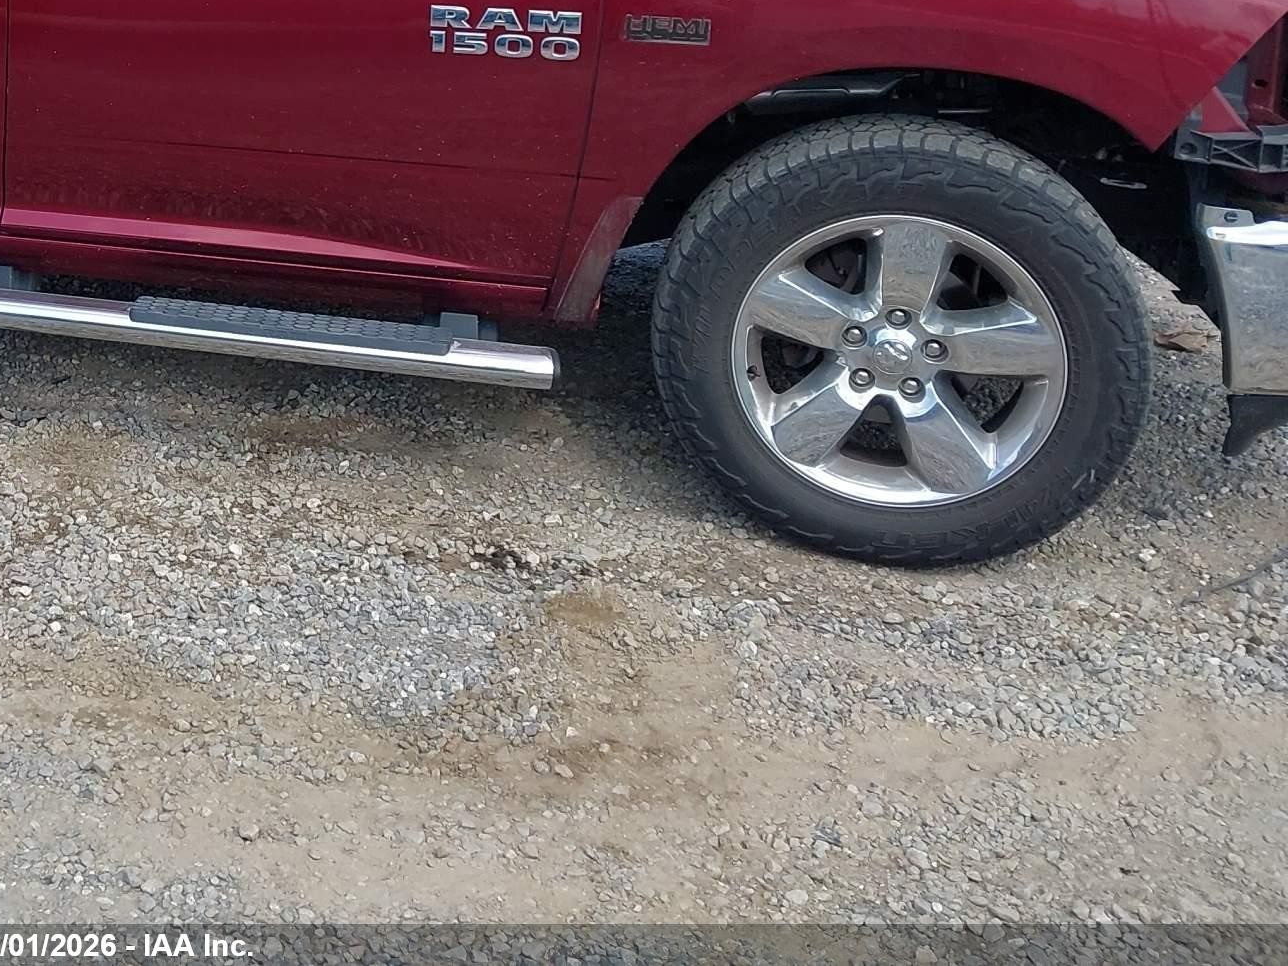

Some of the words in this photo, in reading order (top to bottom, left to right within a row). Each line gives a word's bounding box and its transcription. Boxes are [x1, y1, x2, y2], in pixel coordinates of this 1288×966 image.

[430, 4, 583, 34] RAM
[625, 14, 710, 39] HEMI
[429, 30, 580, 61] 1500
